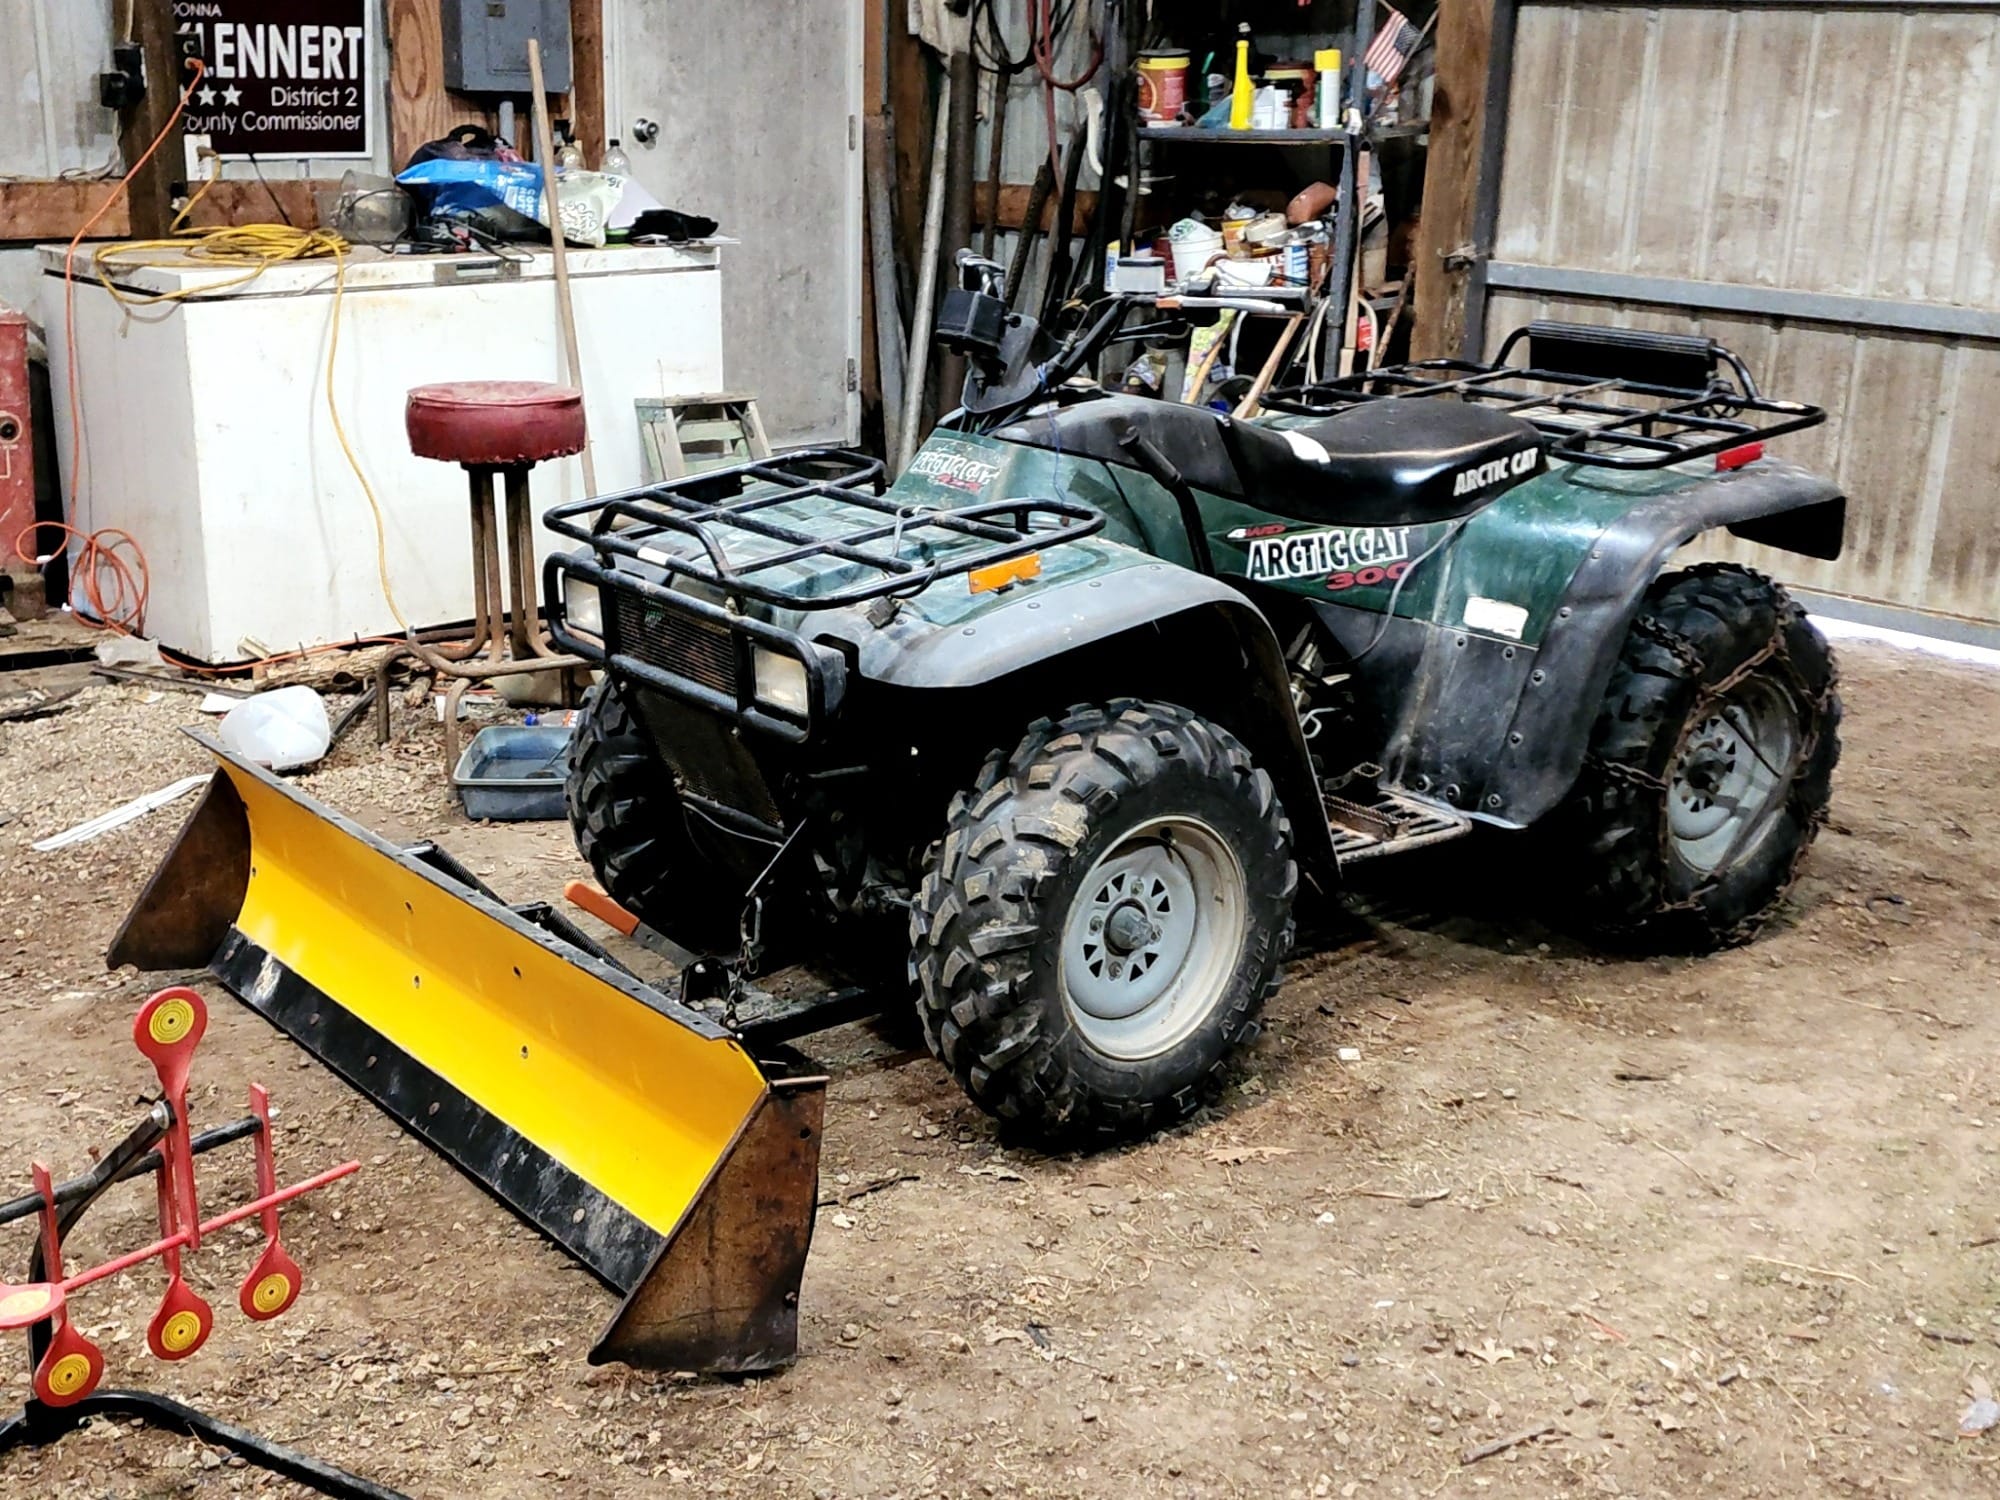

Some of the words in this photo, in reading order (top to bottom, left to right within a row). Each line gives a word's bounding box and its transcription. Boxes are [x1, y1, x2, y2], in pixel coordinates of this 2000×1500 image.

[177, 21, 363, 80] ENNERT
[241, 110, 362, 132] Commissioner
[271, 86, 340, 107] District
[345, 86, 358, 106] 2
[1453, 456, 1509, 497] ARCTIC
[1511, 447, 1539, 475] CAT
[1246, 529, 1350, 581] ARCTIC
[1350, 527, 1411, 566] CAT
